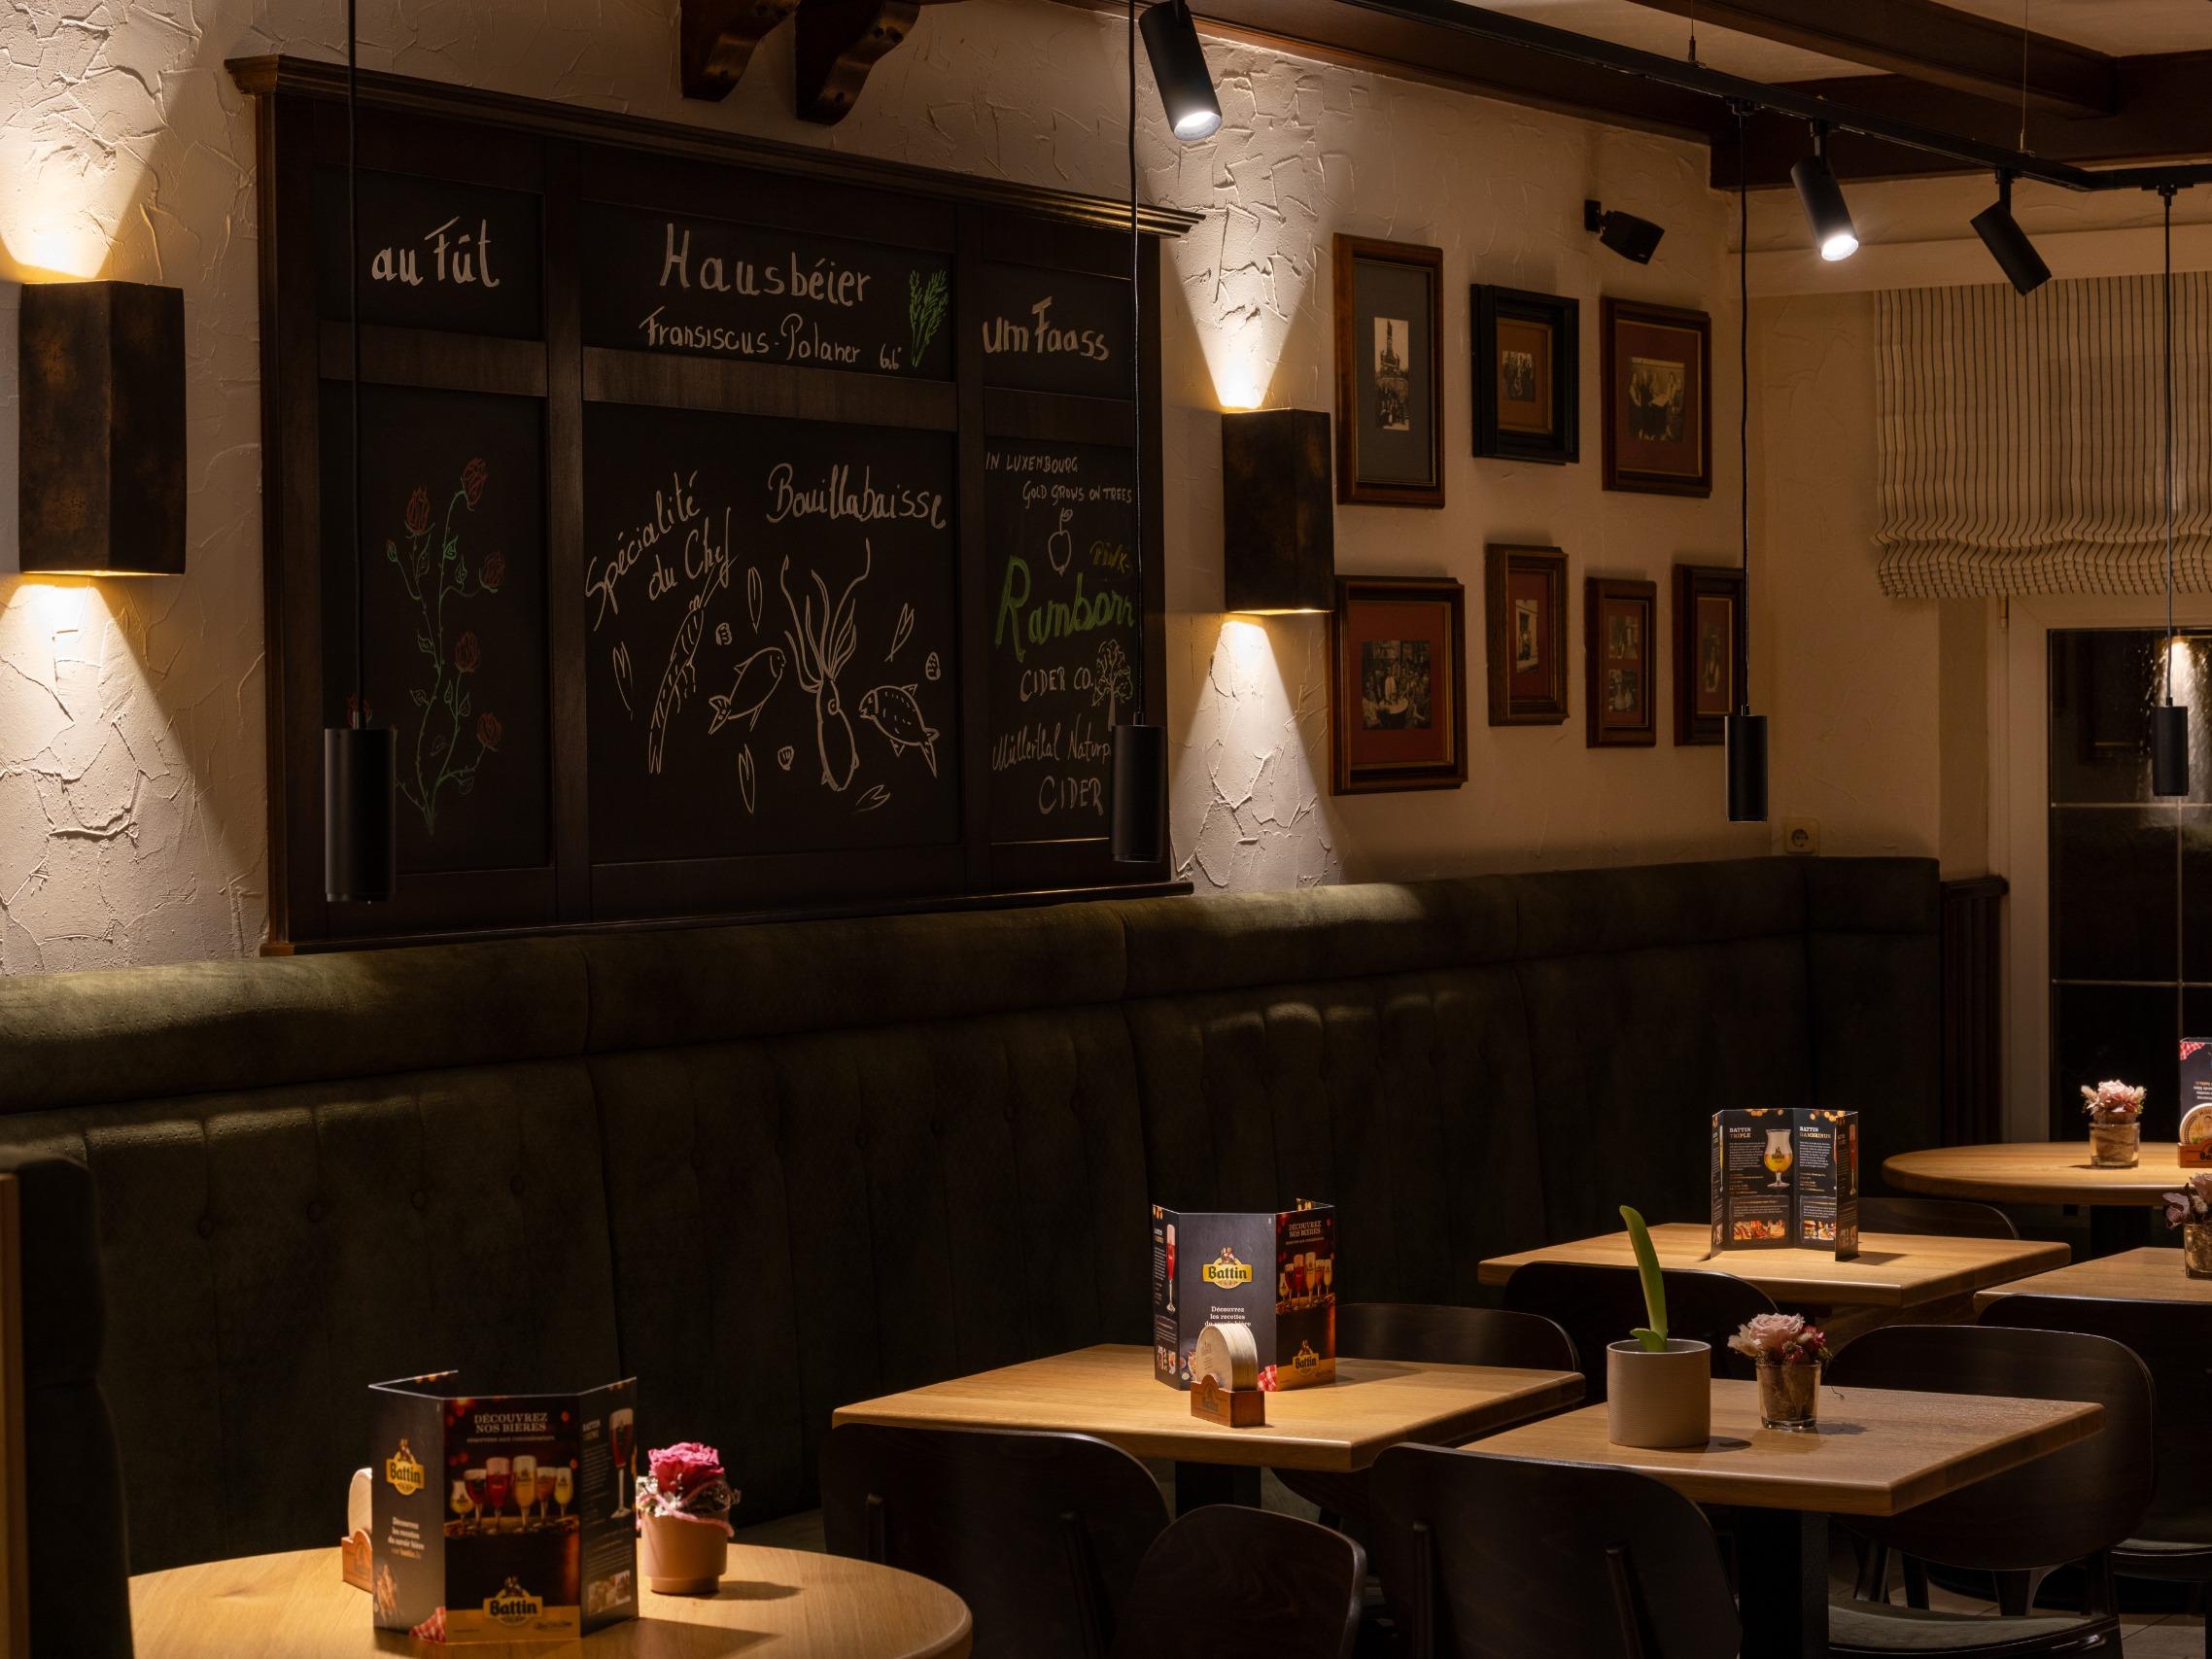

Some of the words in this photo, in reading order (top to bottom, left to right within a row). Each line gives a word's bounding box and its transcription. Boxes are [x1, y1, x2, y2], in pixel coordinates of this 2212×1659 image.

[371, 247, 424, 287] au
[659, 223, 872, 307] Hausbéier
[1031, 295, 1110, 361] Faass
[985, 451, 1000, 470] IN
[766, 462, 947, 529] Bouillabaisse
[1051, 484, 1085, 506] GROWS
[1102, 487, 1132, 504] TREES
[584, 469, 701, 632] Spécialité
[648, 553, 679, 601] du
[1020, 666, 1065, 702] CIDER
[1067, 713, 1112, 766] Naturp
[1039, 776, 1104, 817] CIDER
[1208, 1265, 1247, 1279] Battin
[474, 1424, 500, 1434] NOS
[390, 1462, 421, 1485] Battin
[490, 1599, 537, 1616] Battin
